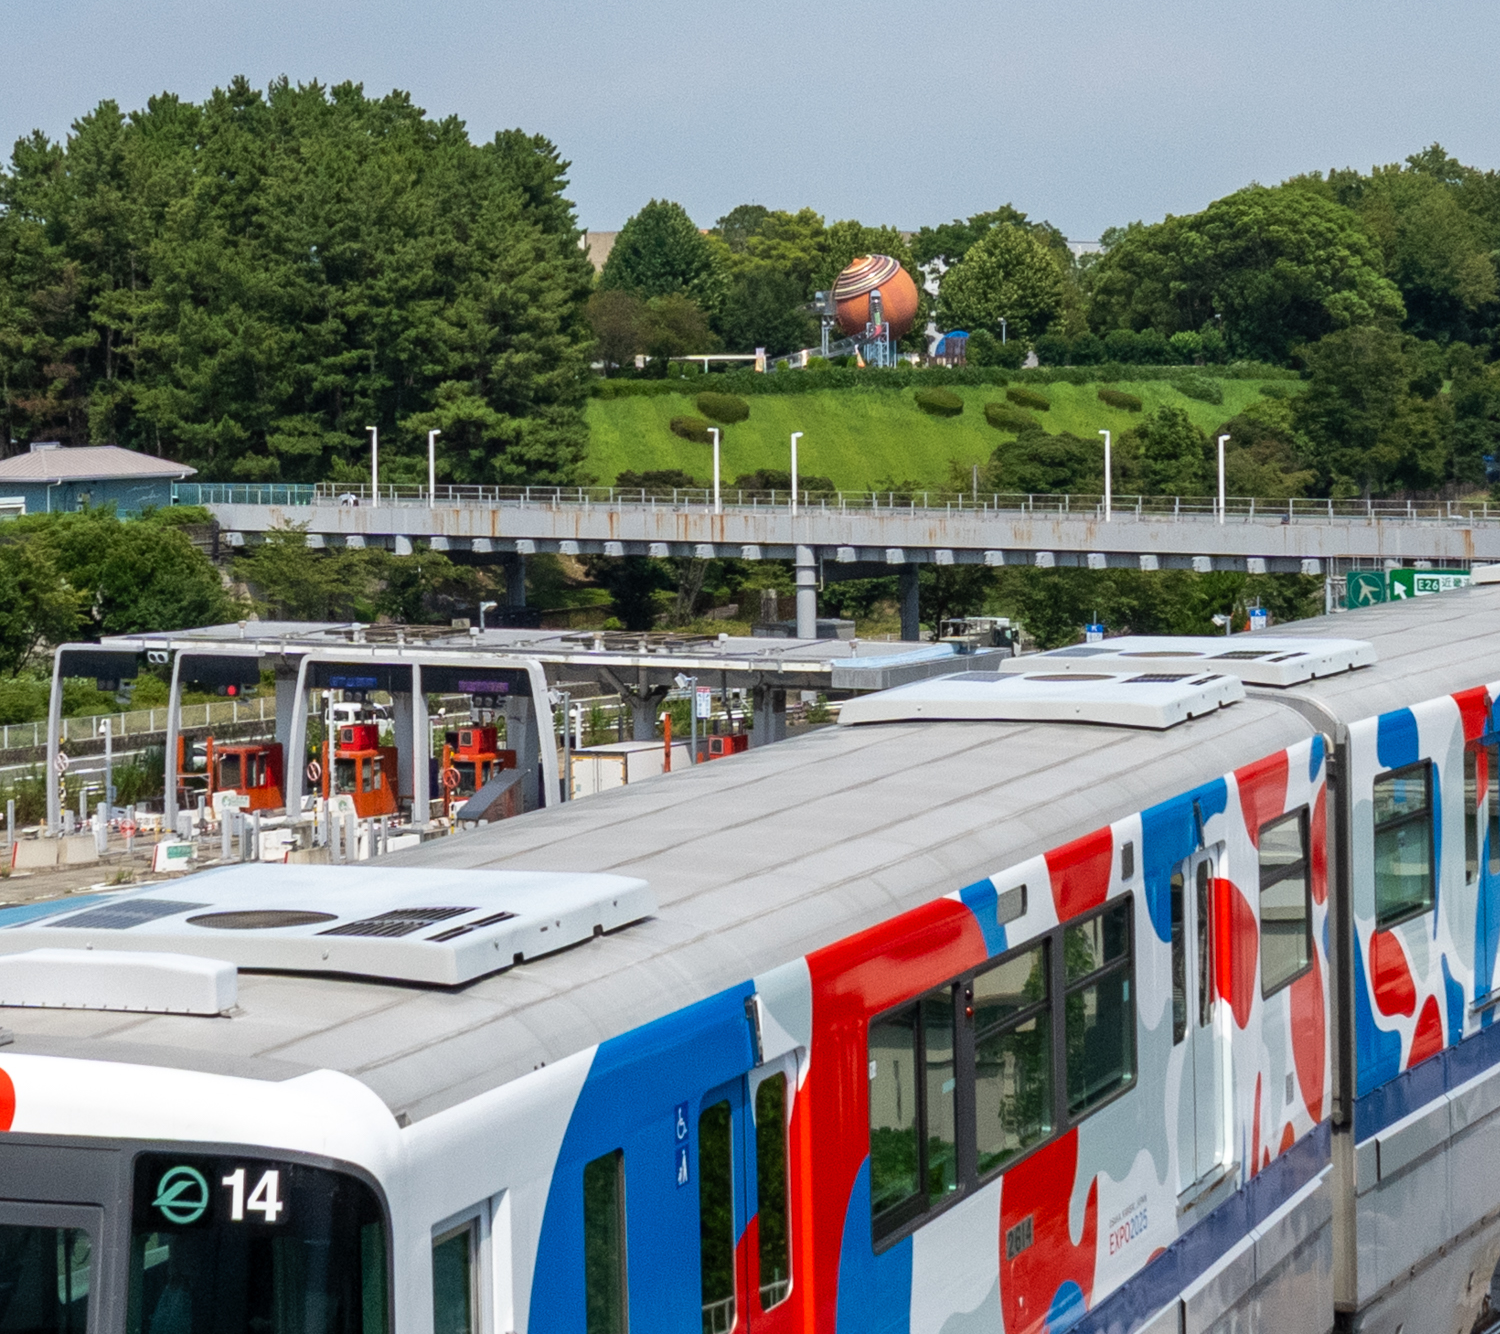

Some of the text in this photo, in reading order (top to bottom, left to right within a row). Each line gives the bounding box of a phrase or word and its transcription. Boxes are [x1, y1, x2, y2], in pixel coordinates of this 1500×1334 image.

[1418, 579, 1438, 591] E26
[222, 1169, 284, 1223] 14
[1007, 1217, 1033, 1259] 2614
[1109, 1208, 1148, 1255] EXPO2025
